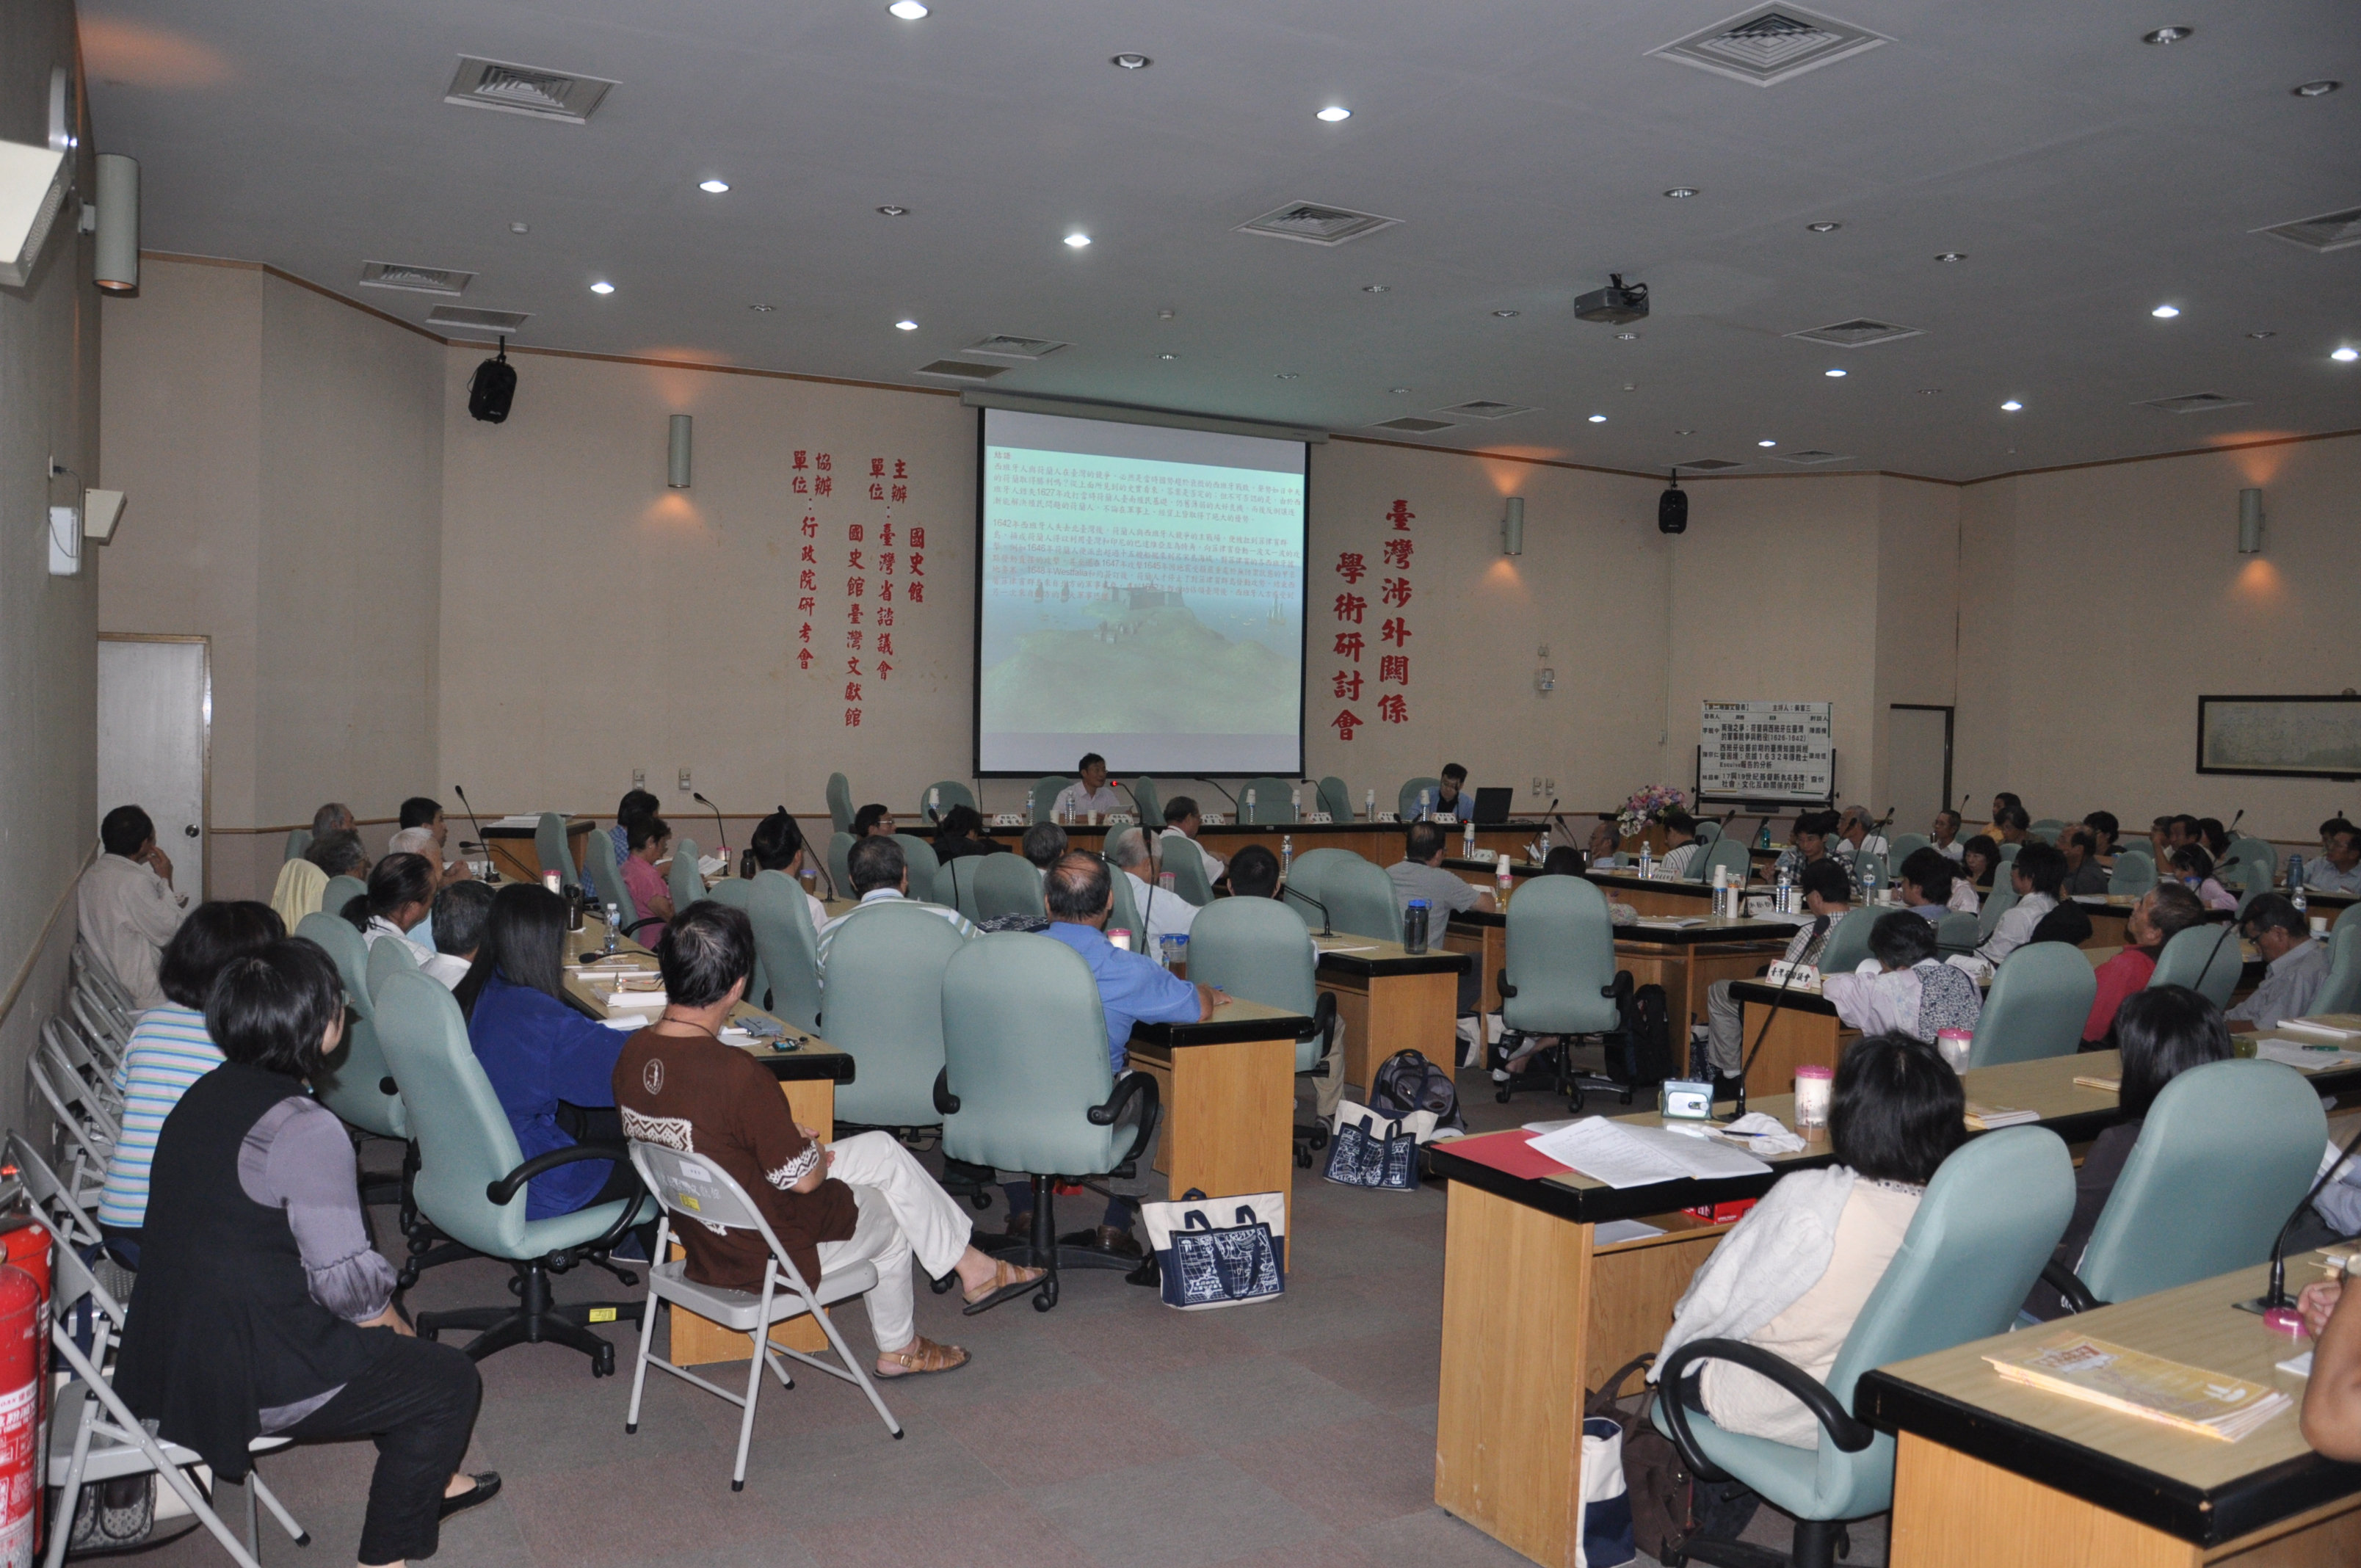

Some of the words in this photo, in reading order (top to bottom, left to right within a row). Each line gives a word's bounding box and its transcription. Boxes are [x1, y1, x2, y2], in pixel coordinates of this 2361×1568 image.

[844, 524, 865, 727] 國史館臺灣文獻館
[908, 528, 924, 603] 國史館
[1331, 552, 1368, 741] 學術研討會
[1377, 499, 1415, 724] 臺灣涉外關係
